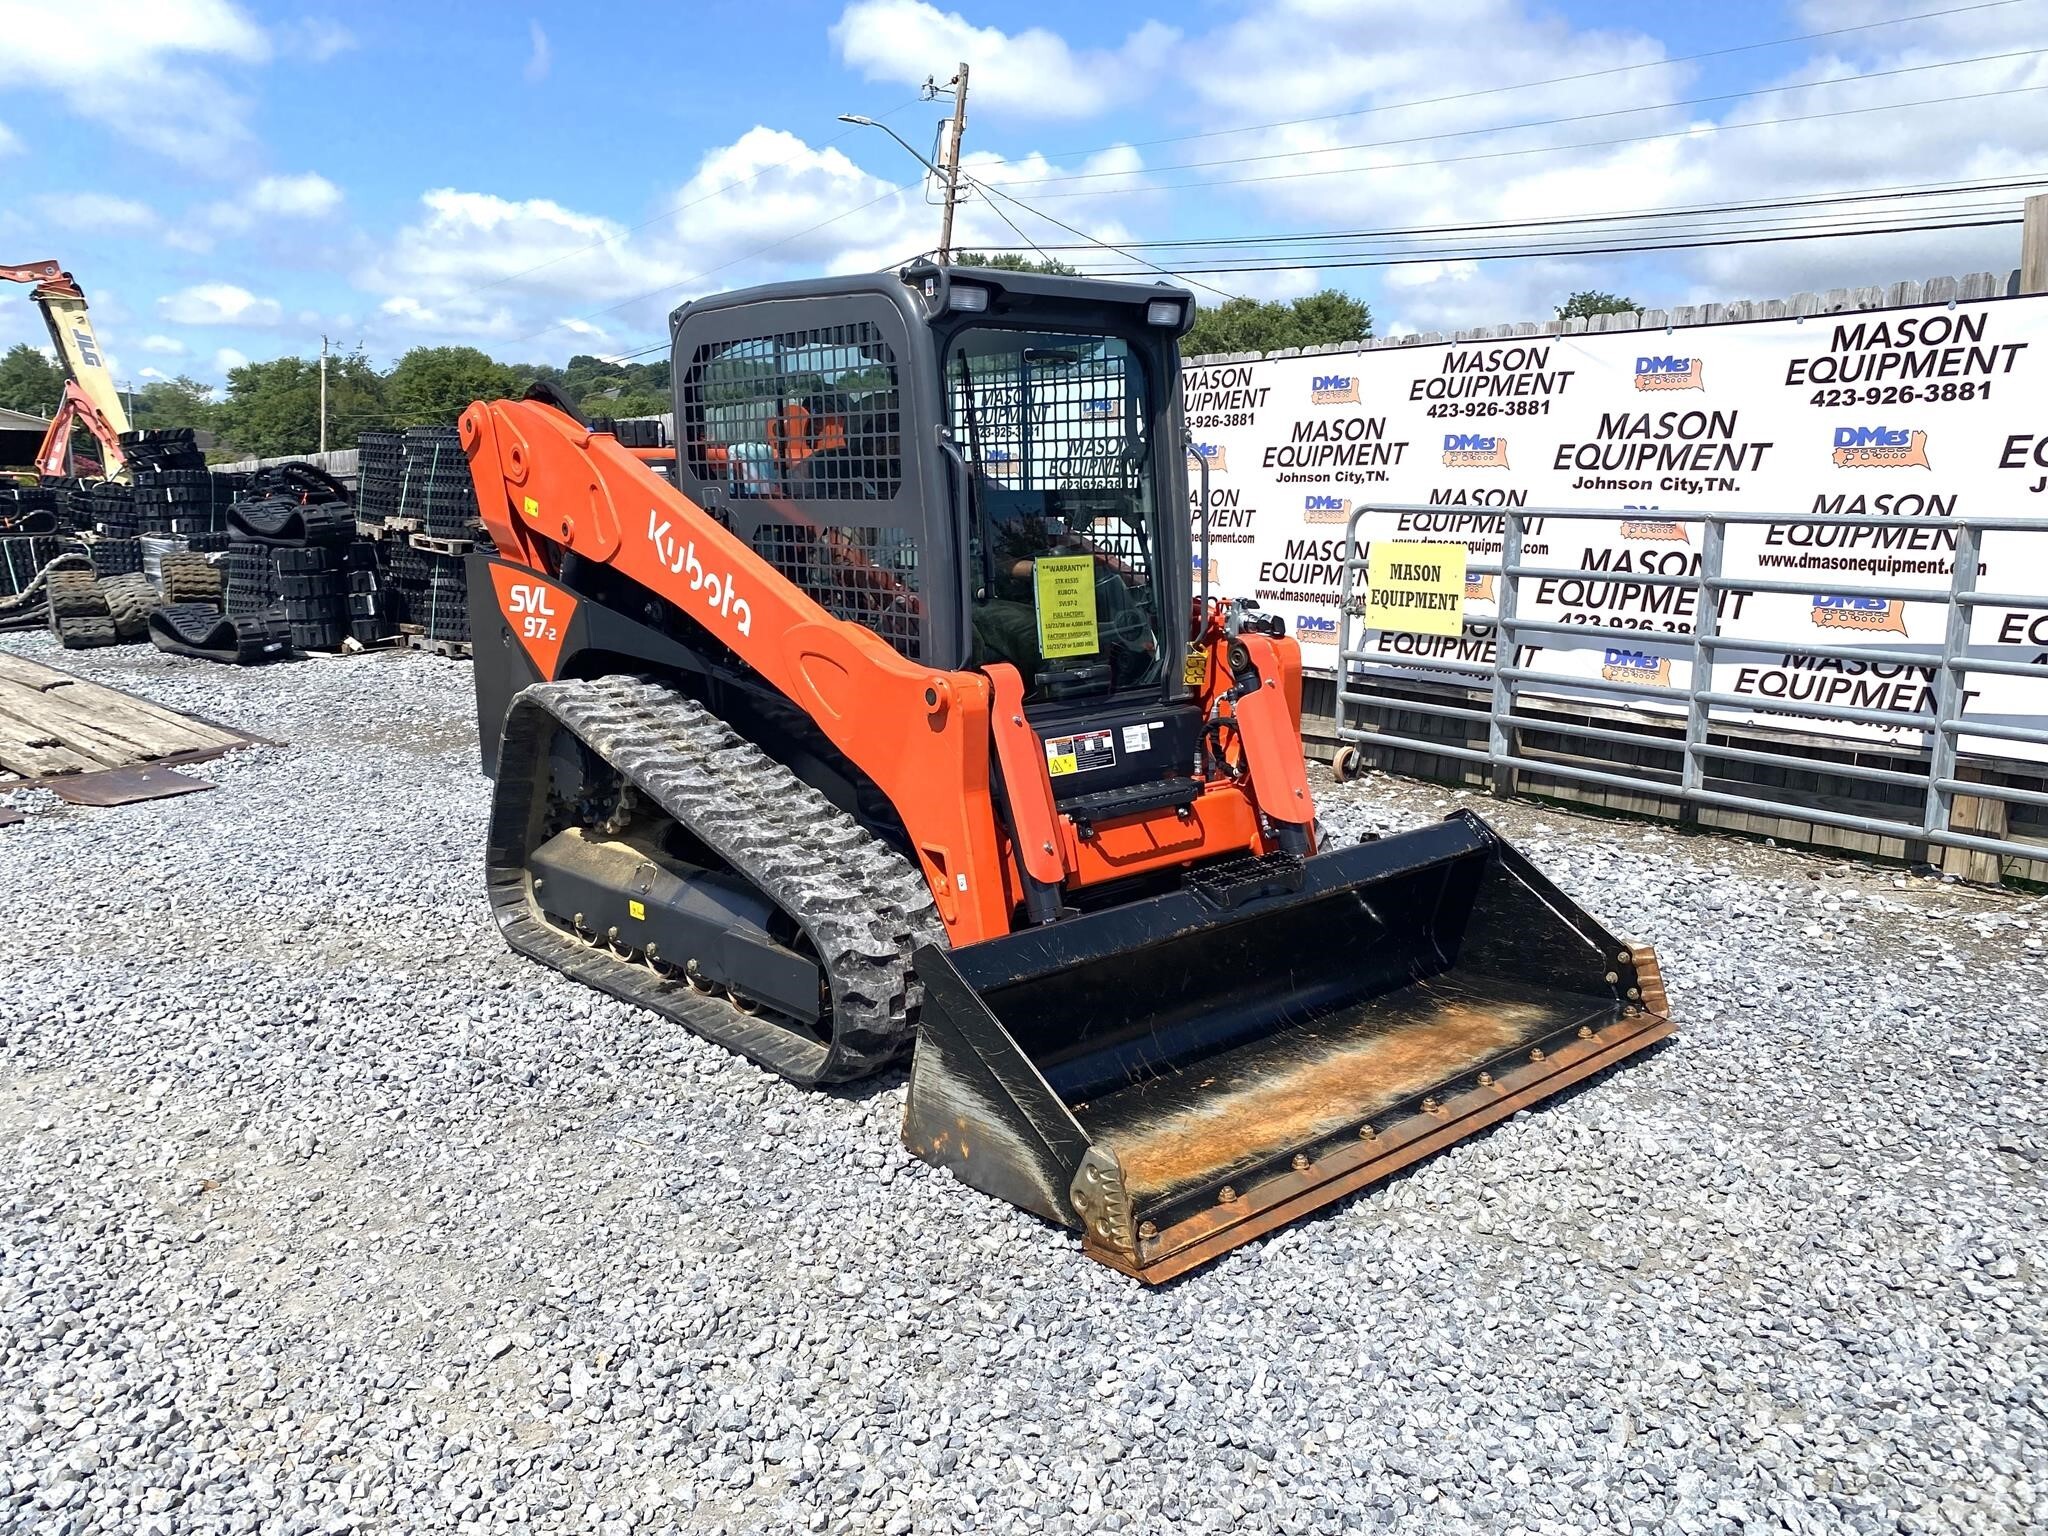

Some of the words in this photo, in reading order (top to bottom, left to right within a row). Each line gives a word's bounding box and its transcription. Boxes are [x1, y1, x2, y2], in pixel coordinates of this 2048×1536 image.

[1831, 312, 1988, 353] MASON
[72, 328, 102, 368] JLG
[1442, 346, 1550, 374] MASON
[1784, 342, 2029, 386] EQUIPMENT
[1182, 366, 1253, 391] MASON
[1408, 371, 1575, 401] EQUIPMENT
[1184, 387, 1270, 412] UIPMENT
[1810, 381, 1991, 407] 423-926-3881
[1185, 412, 1254, 428] 3-926-3881
[1427, 400, 1550, 418] 423-926-3881
[1292, 417, 1386, 443] MASON
[1596, 410, 1738, 440] MASON
[1263, 442, 1409, 468] EQUIPMENT
[1553, 442, 1774, 471] EQUIPMENT
[1276, 472, 1331, 483] Johnson
[1572, 476, 1653, 490] Johnson
[1429, 488, 1528, 507] MASON
[1811, 494, 1958, 517] MASON
[1765, 523, 1958, 551] EQUIPMEN
[647, 509, 752, 638] Kubota
[1259, 562, 1369, 587] EQUIPMN
[1389, 563, 1441, 582] MASON
[1758, 552, 1987, 576] www.dmasonequipment.m
[508, 584, 555, 616] SVL
[1370, 588, 1459, 611] EQUIPMENT
[1536, 578, 1753, 621] EQUIPMET
[523, 616, 557, 641] 97-2
[1558, 613, 1722, 637] 423-926-381
[1378, 632, 1543, 668] EQUIPMET
[1604, 647, 1659, 669] DMes
